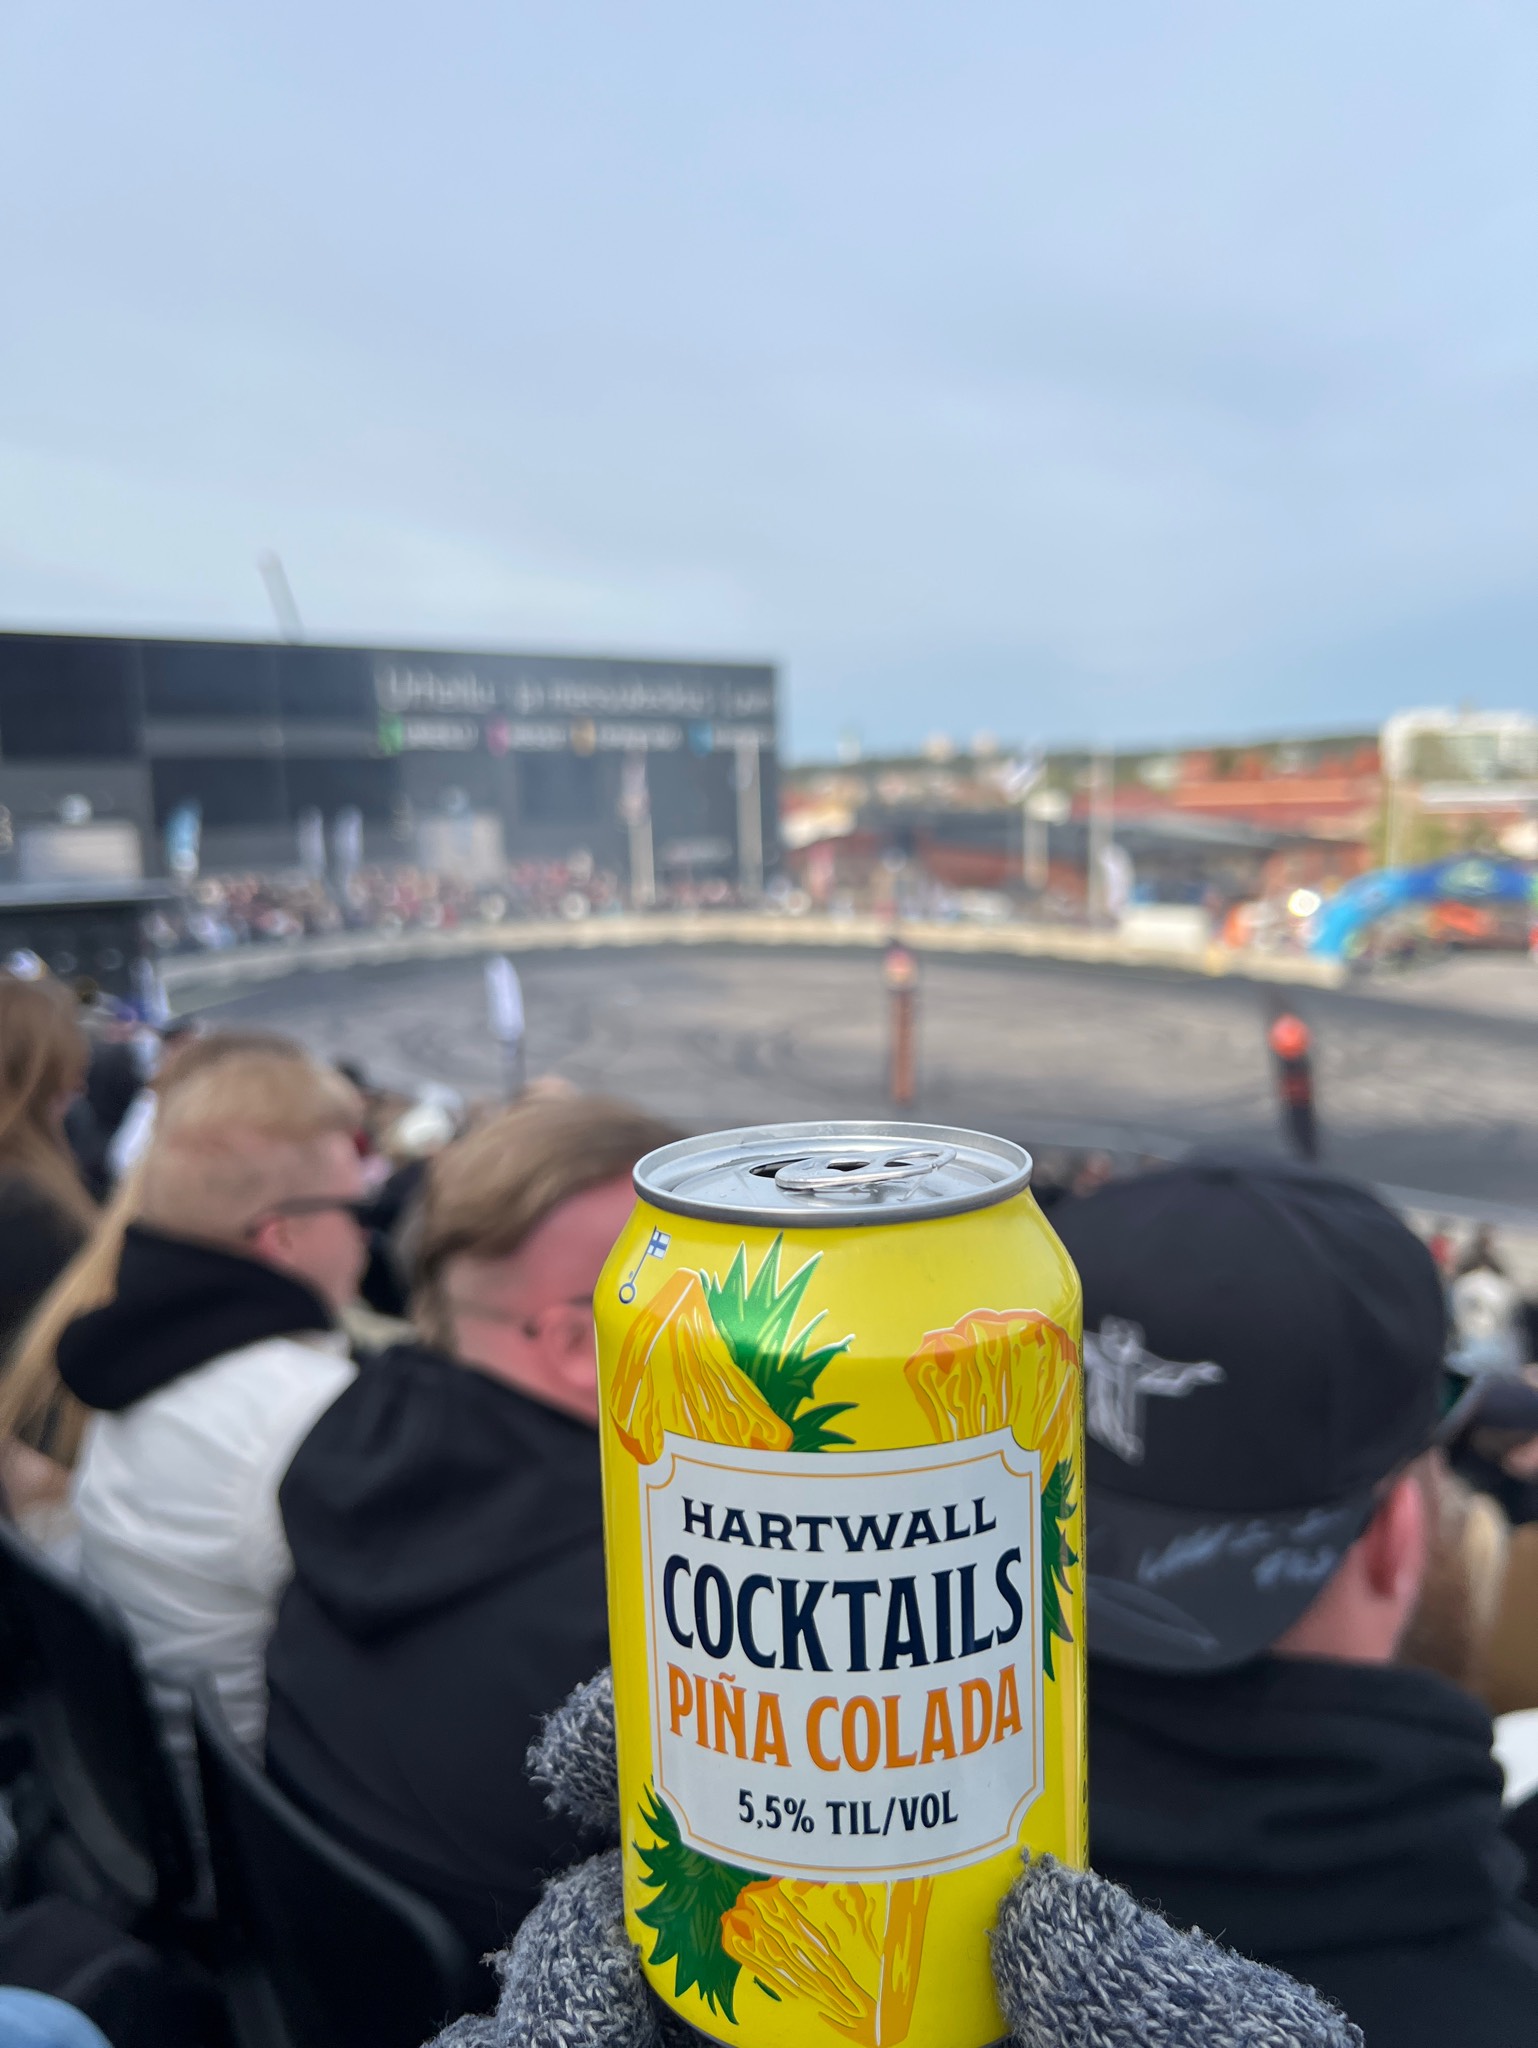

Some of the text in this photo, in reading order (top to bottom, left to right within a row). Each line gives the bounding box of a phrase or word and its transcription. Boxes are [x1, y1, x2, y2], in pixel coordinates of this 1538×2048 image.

[681, 1495, 997, 1553] HARTWALL
[662, 1546, 1024, 1673] COCKTAILS
[666, 1662, 1024, 1773] PIÑA COLADA
[738, 1788, 959, 1836] 5,5% TIL/VOL
